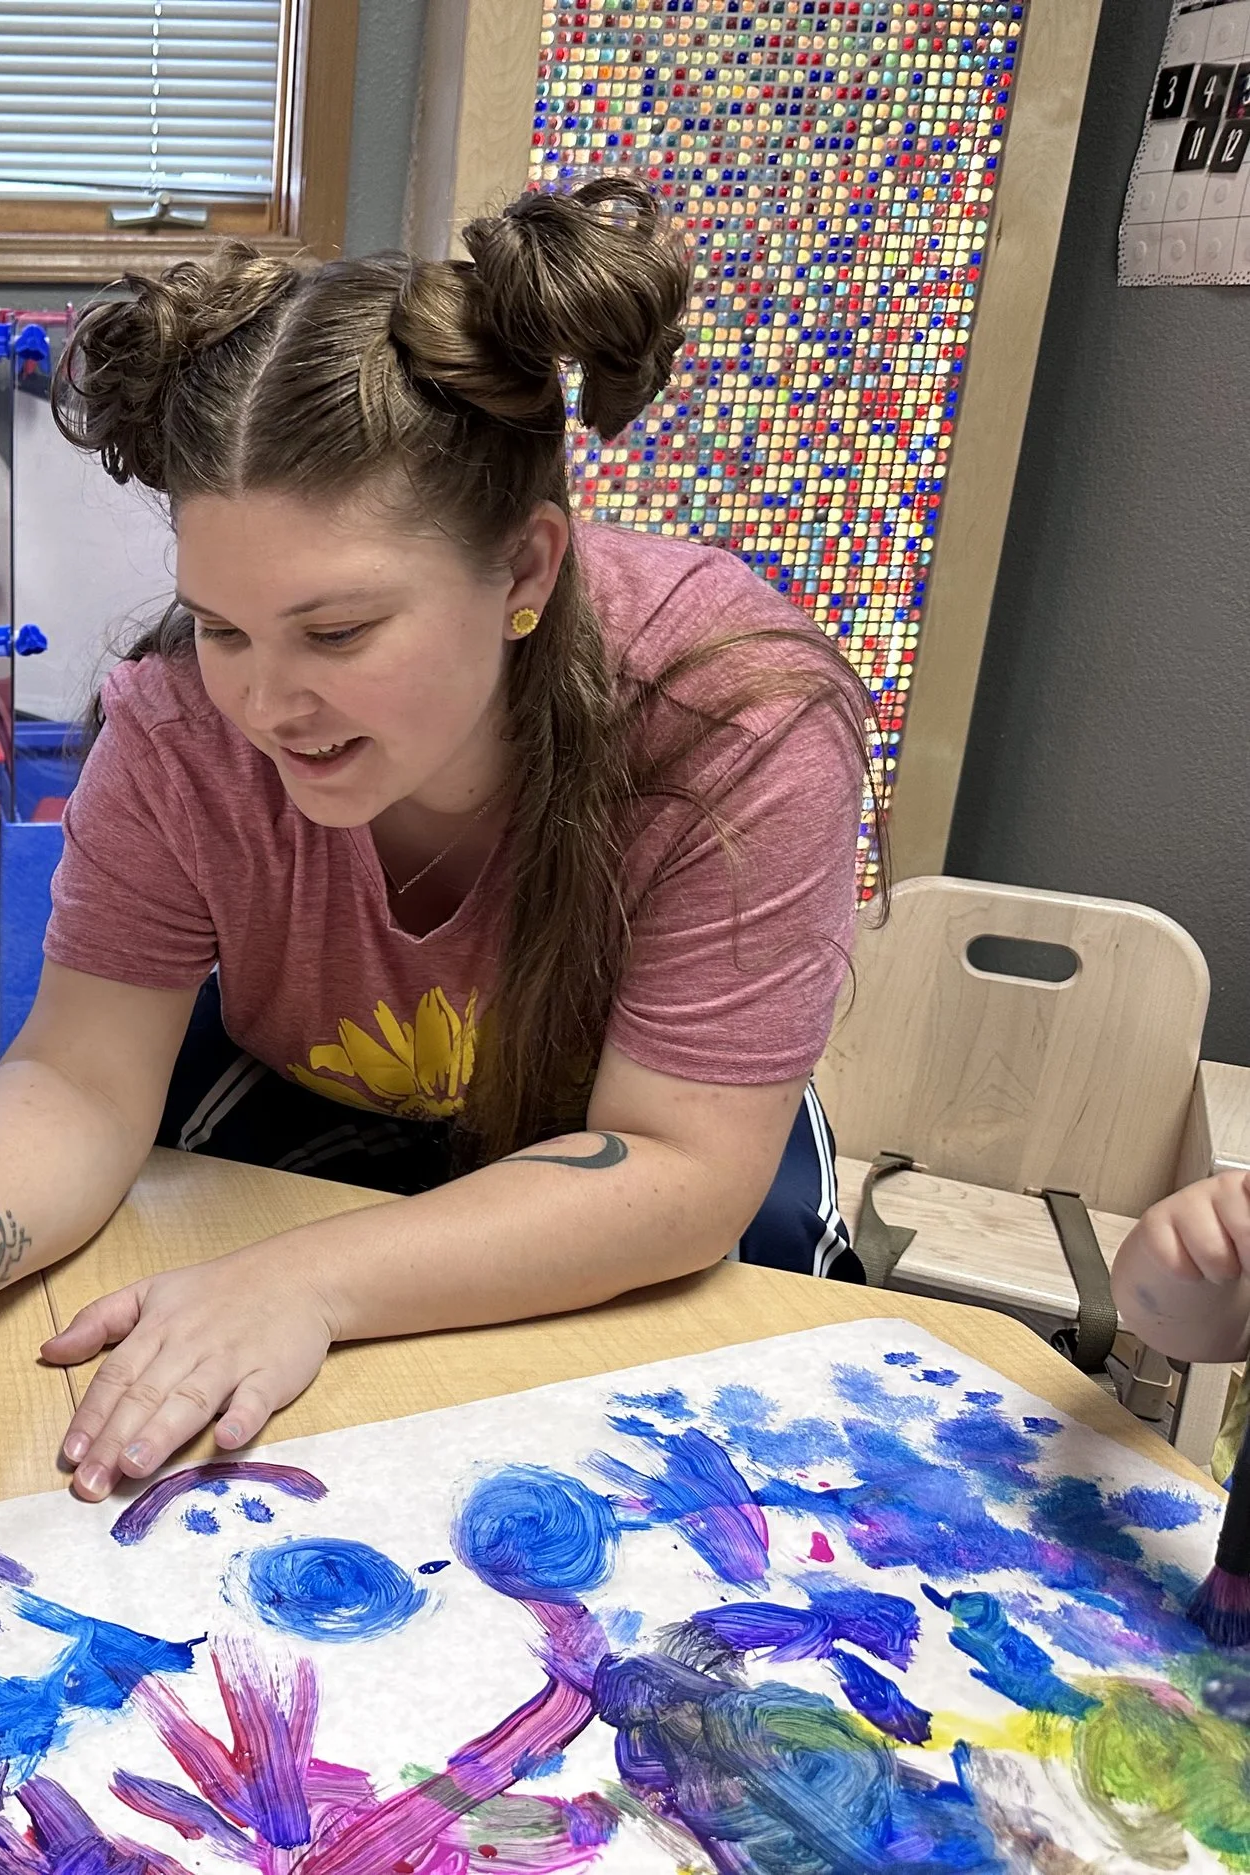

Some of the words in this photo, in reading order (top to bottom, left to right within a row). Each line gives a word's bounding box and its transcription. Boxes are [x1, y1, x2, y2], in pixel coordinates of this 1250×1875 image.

[1163, 75, 1178, 110] 3
[1203, 74, 1218, 110] 4
[1187, 126, 1206, 161] 11
[1220, 127, 1244, 164] 12
